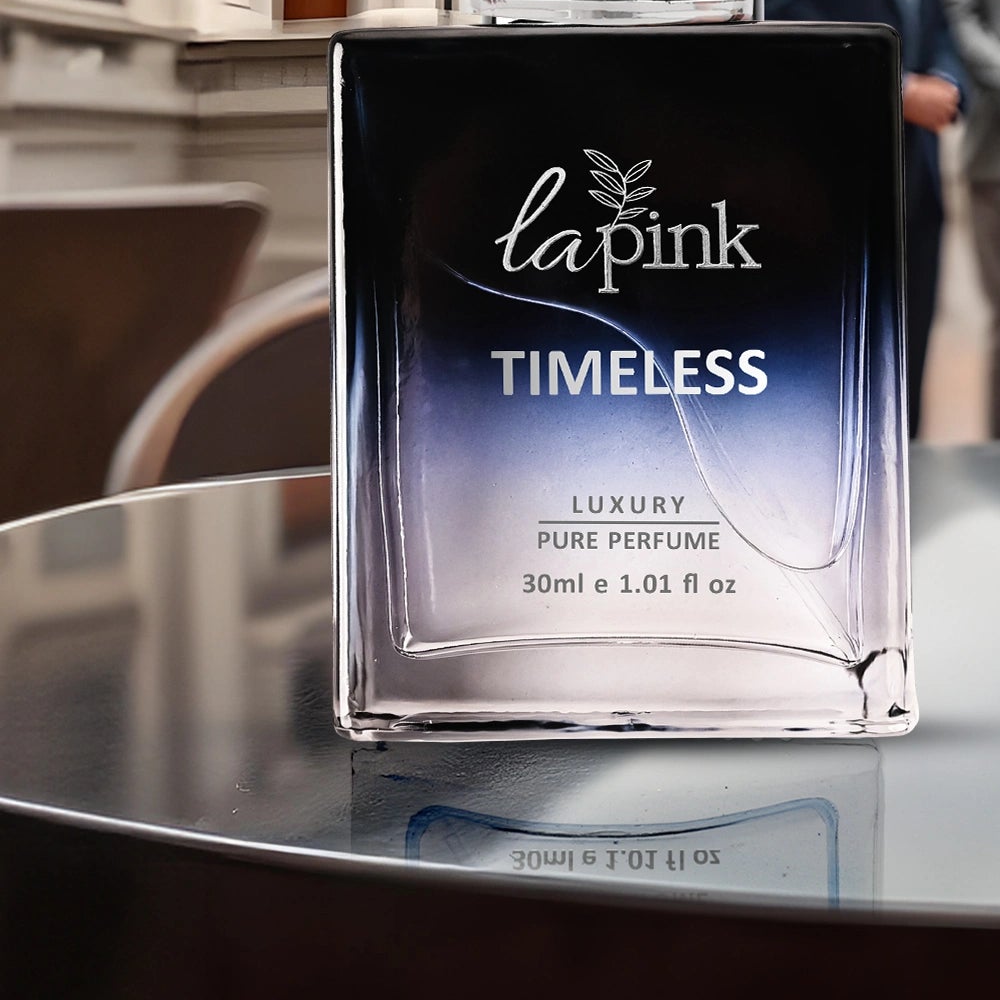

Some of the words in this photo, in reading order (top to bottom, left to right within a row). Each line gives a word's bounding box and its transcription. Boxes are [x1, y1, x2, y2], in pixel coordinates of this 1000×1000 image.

[490, 349, 768, 396] TIMELESS
[572, 495, 685, 514] LUXURY
[537, 531, 598, 550] PURE
[609, 531, 720, 550] PERFUME
[522, 572, 584, 594] 30ml
[594, 577, 609, 594] e
[619, 573, 672, 594] 1.01
[682, 572, 698, 594] fl
[708, 578, 736, 594] oz
